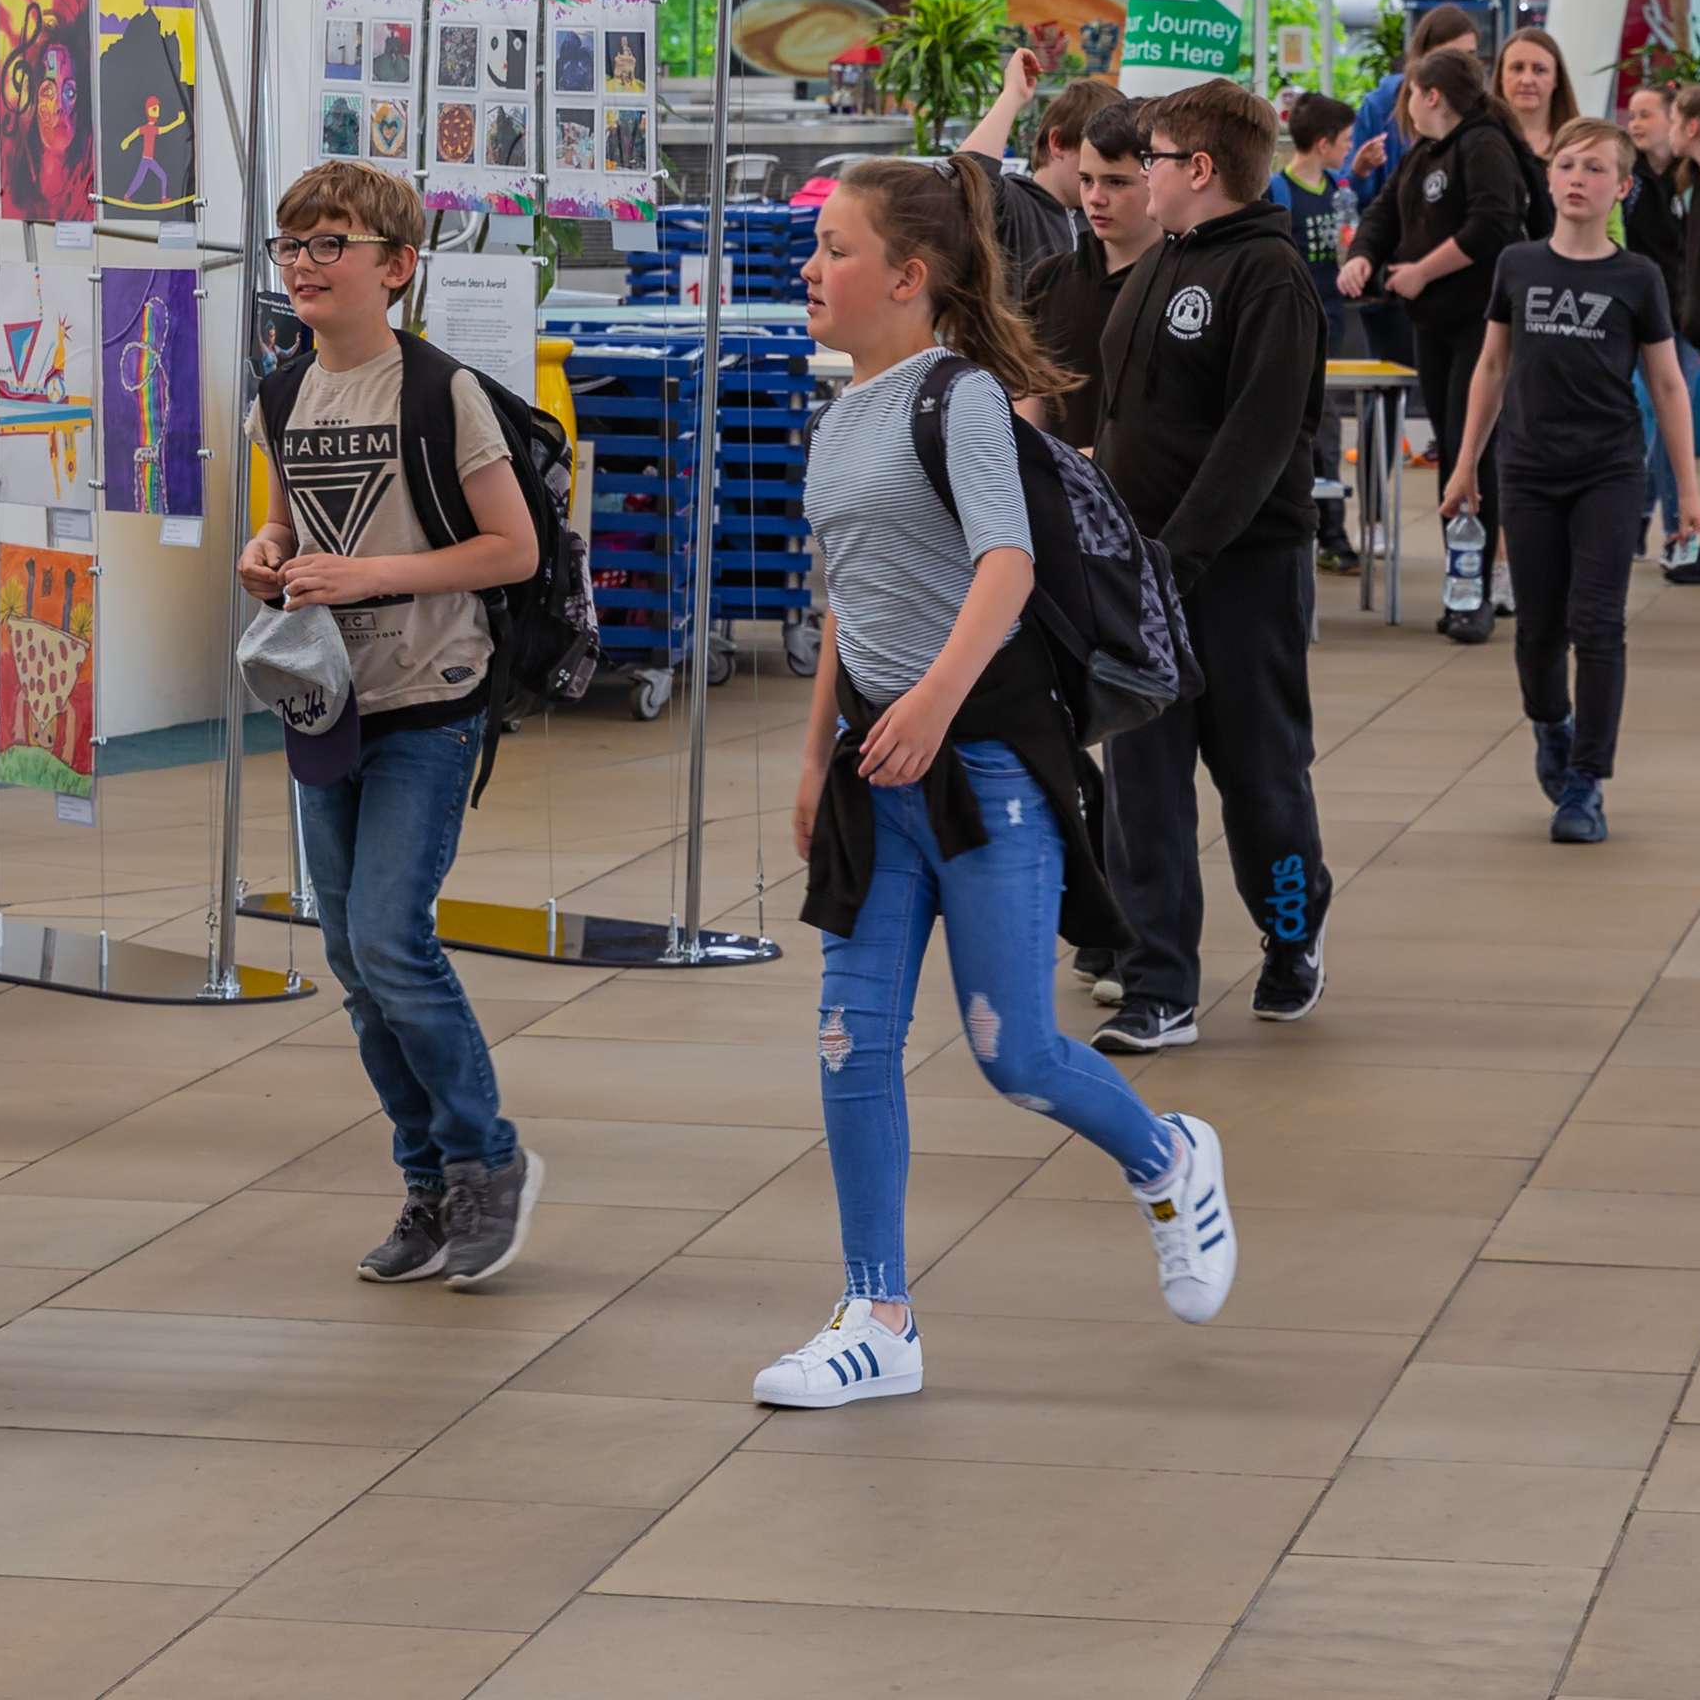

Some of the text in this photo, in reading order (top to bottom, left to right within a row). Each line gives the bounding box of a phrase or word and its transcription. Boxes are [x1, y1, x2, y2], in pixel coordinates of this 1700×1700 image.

[1126, 10, 1239, 46] ur Journey
[1123, 40, 1225, 67] arts Here
[441, 277, 507, 289] Creative Stars Award
[1525, 286, 1613, 328] EA7
[283, 432, 392, 457] HARLEM
[277, 685, 328, 727] New York
